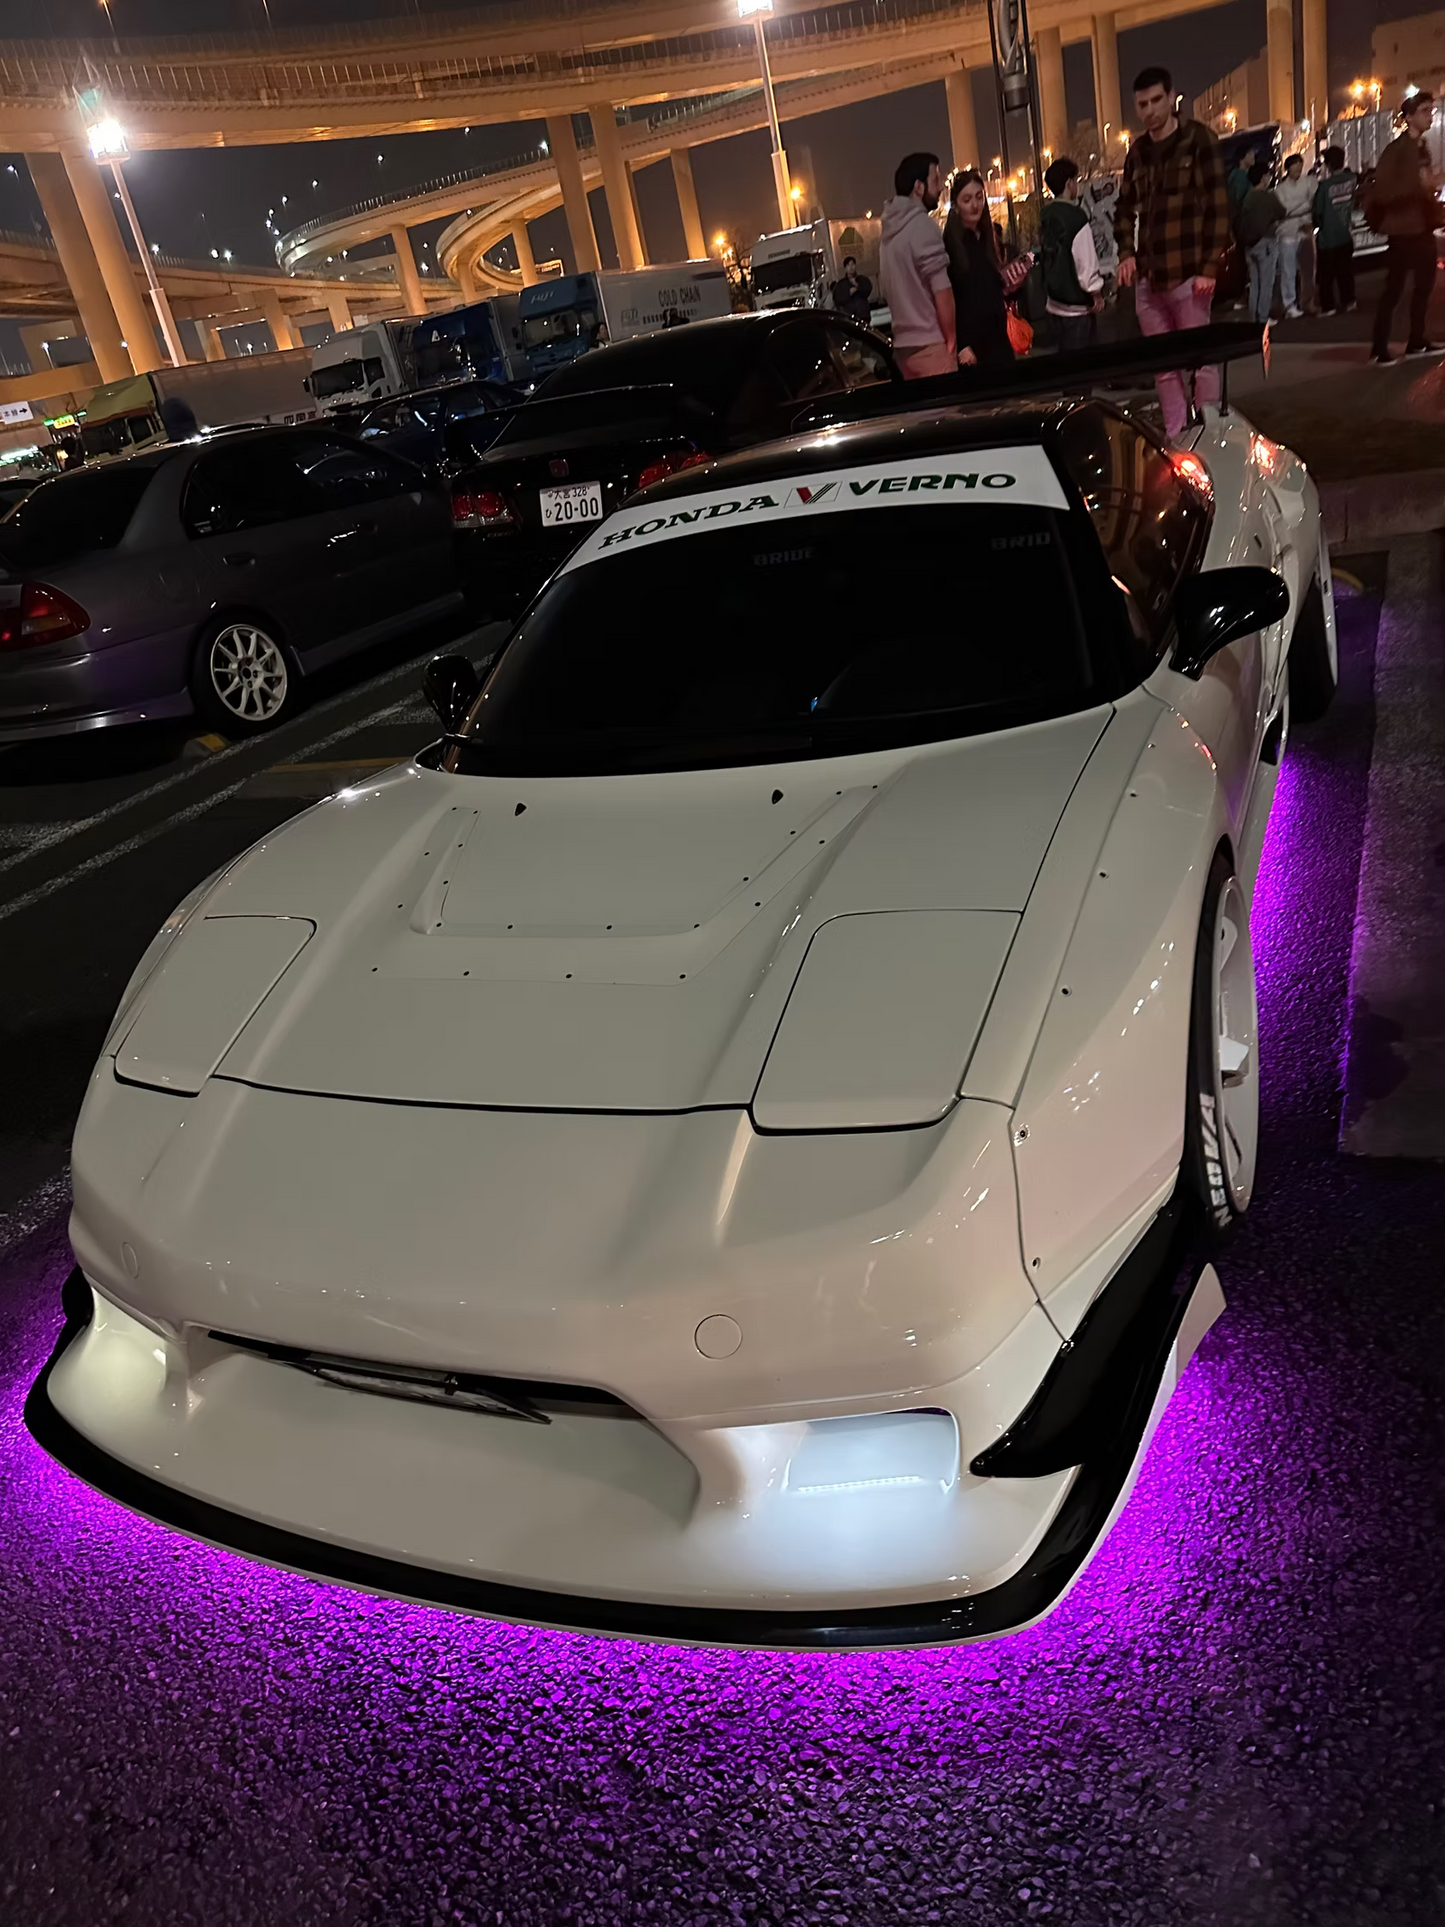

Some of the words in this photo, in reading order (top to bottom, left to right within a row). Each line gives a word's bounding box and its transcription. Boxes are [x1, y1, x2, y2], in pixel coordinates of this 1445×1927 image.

[658, 289, 678, 307] COLD
[679, 285, 702, 304] CHAIN
[572, 486, 588, 498] 328
[554, 497, 599, 522] 20-00
[598, 494, 779, 549] HONDA
[849, 473, 1016, 495] VERNO
[1200, 1092, 1233, 1227] NEOVA
